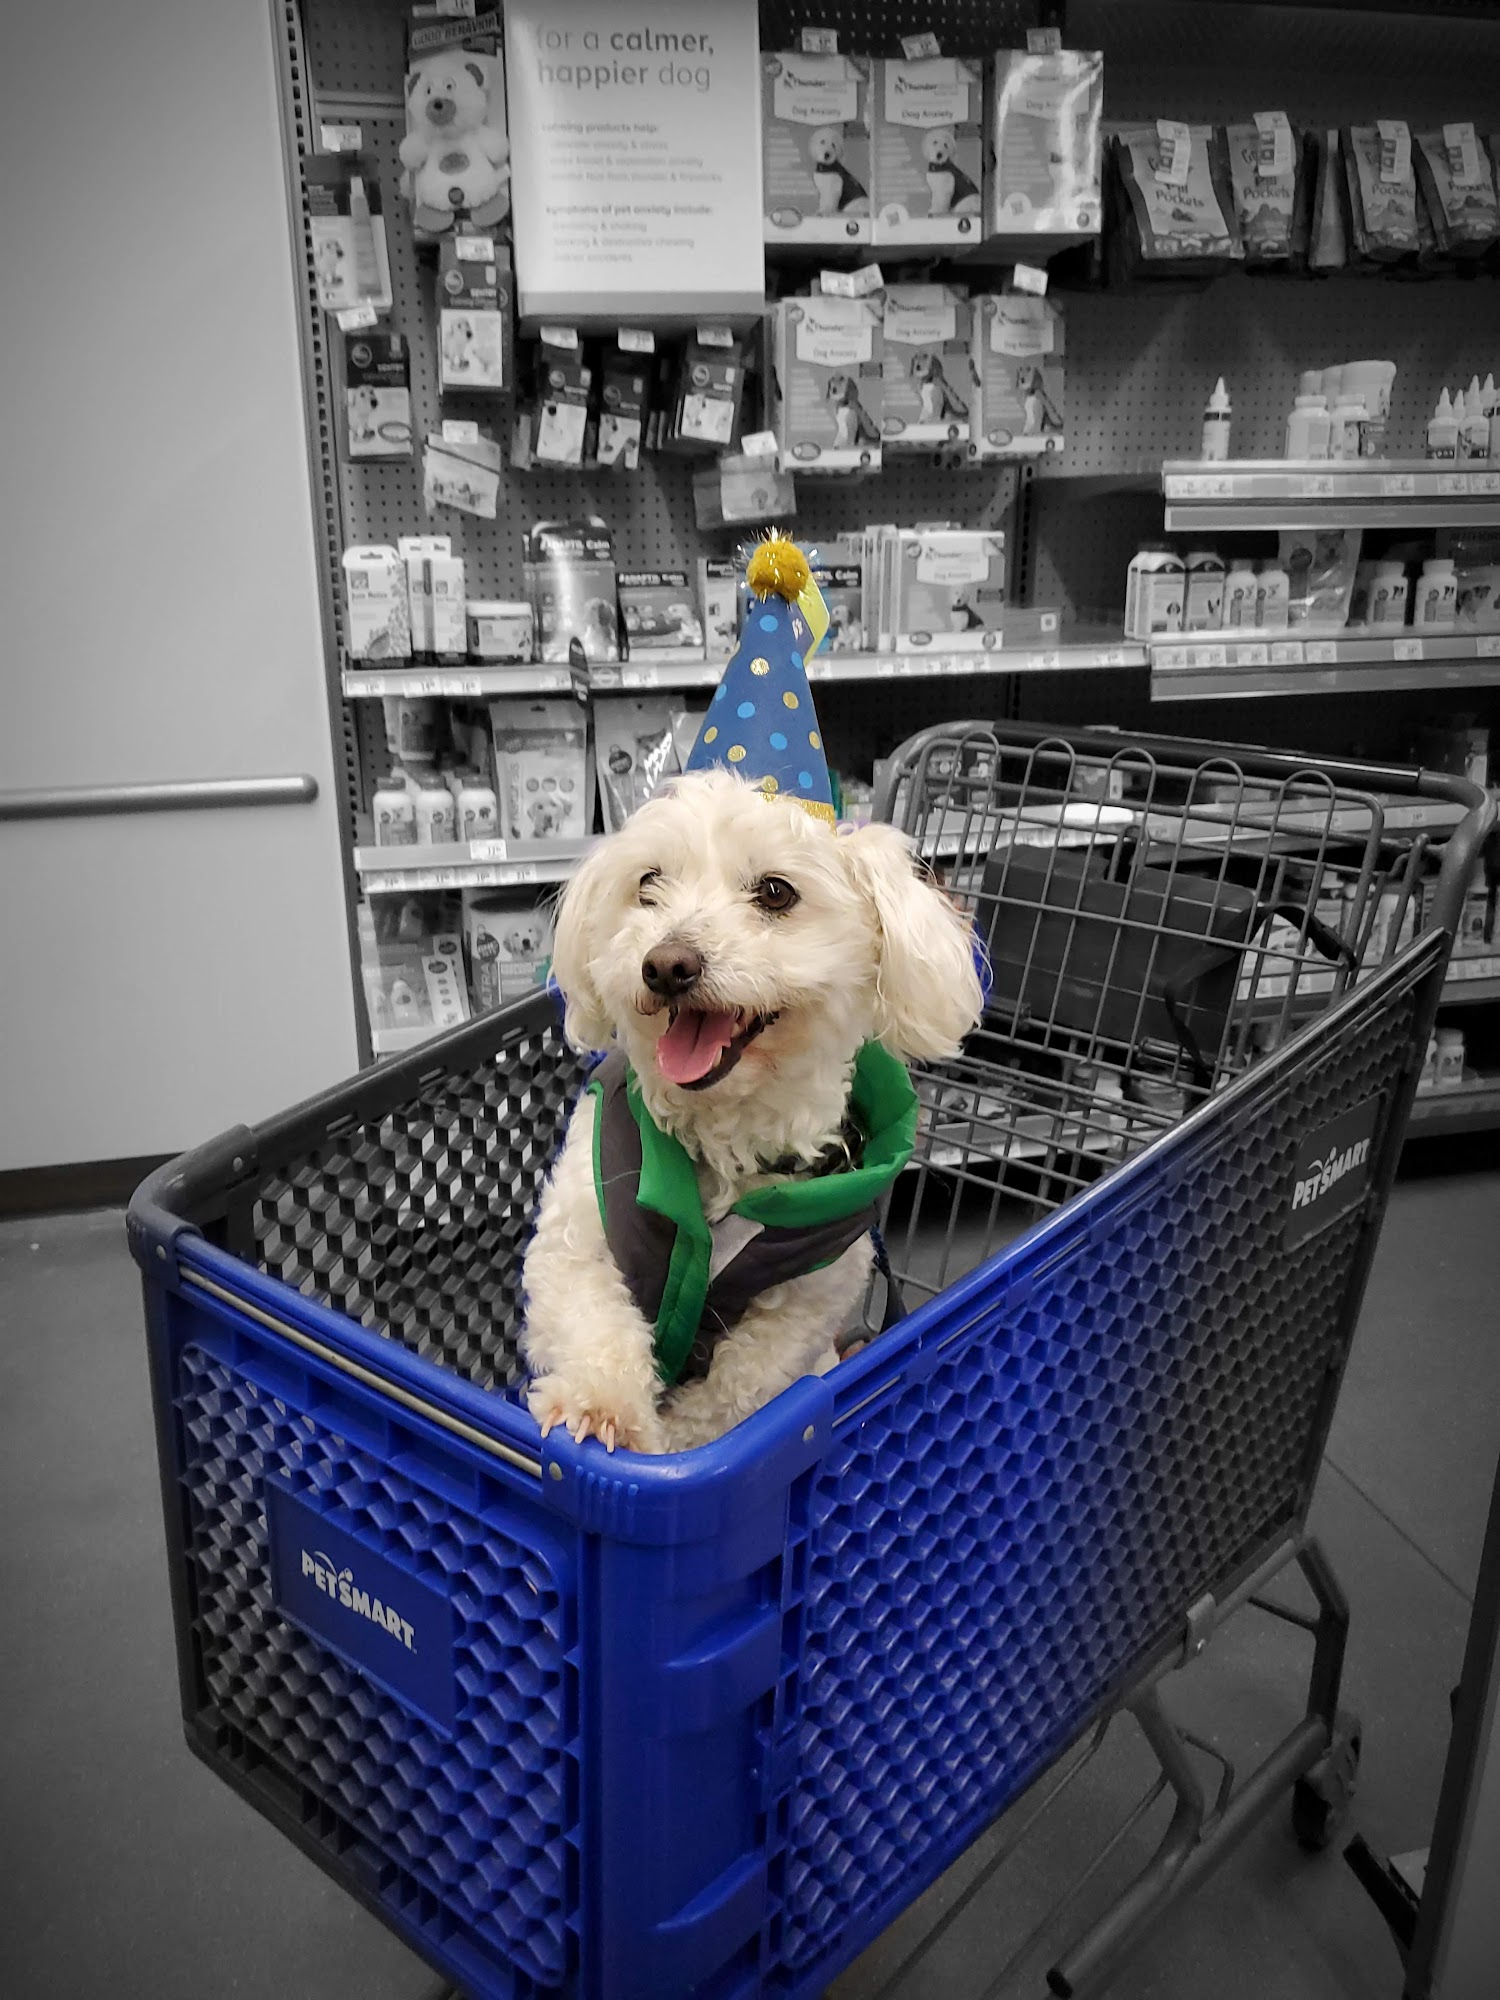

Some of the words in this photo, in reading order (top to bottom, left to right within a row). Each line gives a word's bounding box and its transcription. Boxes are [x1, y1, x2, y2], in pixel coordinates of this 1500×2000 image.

[582, 31, 600, 50] a
[609, 26, 714, 57] calmer,
[537, 59, 649, 90] happier
[658, 61, 711, 92] dog
[1156, 189, 1205, 207] Pockets
[1243, 186, 1290, 200] Pockets
